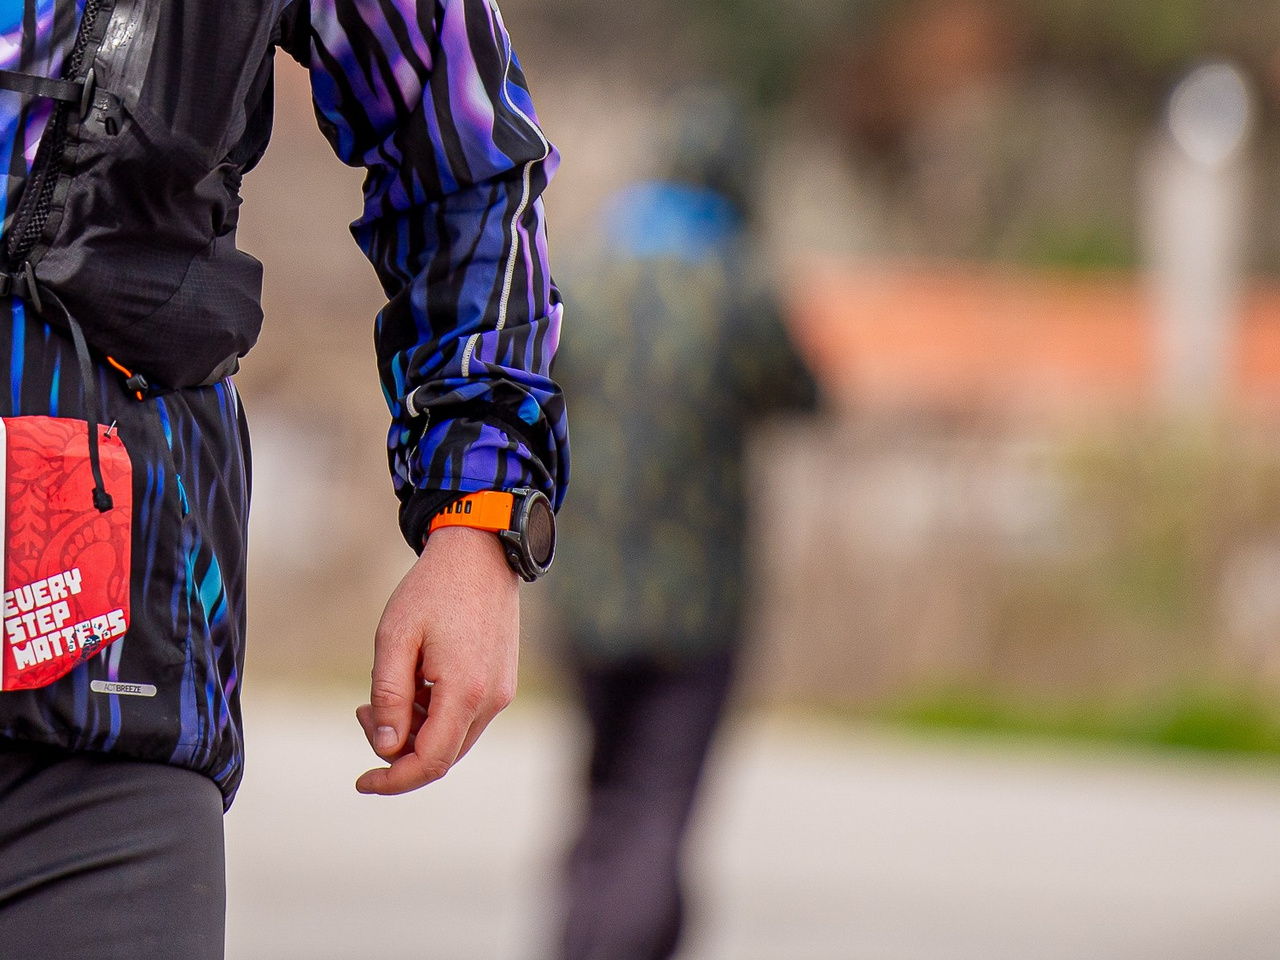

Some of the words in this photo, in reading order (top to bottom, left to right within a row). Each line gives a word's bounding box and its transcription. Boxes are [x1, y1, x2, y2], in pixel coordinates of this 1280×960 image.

[3, 567, 82, 618] EVERY
[5, 600, 71, 645] STEP
[11, 608, 127, 671] MATTERS
